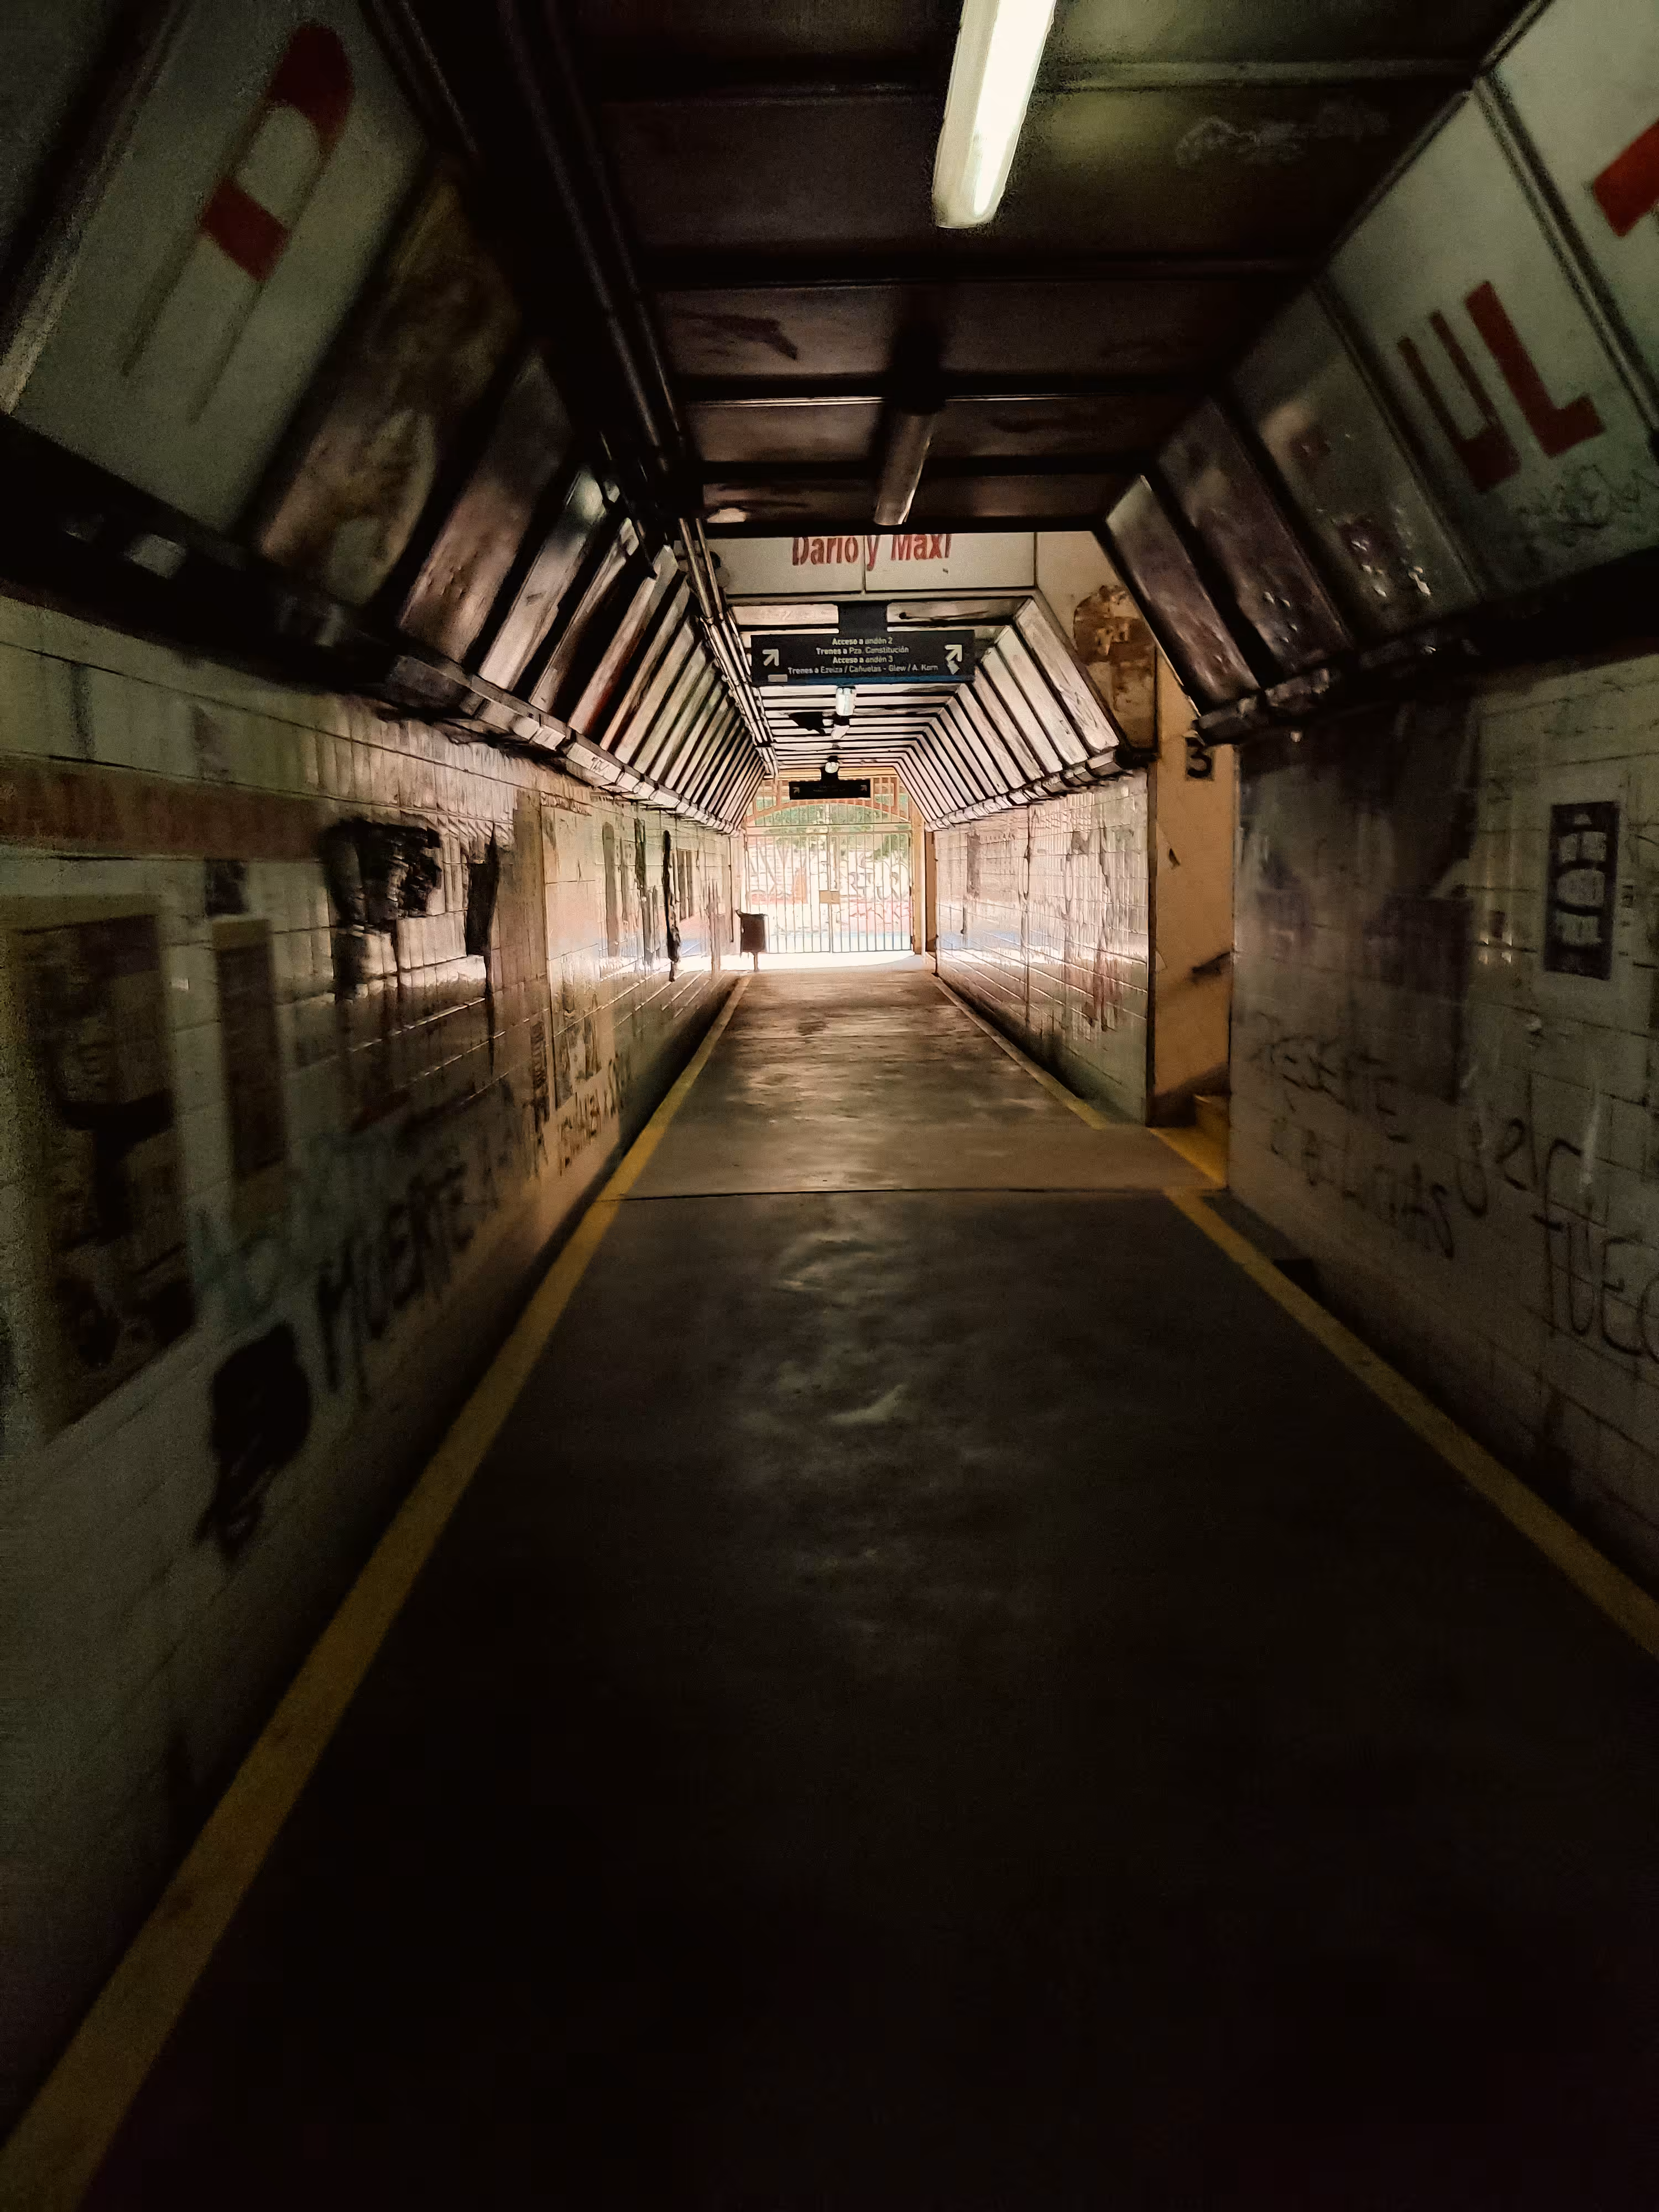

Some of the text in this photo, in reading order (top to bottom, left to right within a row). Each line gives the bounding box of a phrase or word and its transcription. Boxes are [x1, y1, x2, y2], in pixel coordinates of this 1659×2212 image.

[867, 535, 881, 571] y
[865, 645, 909, 654] Constitución
[1185, 737, 1212, 779] 3
